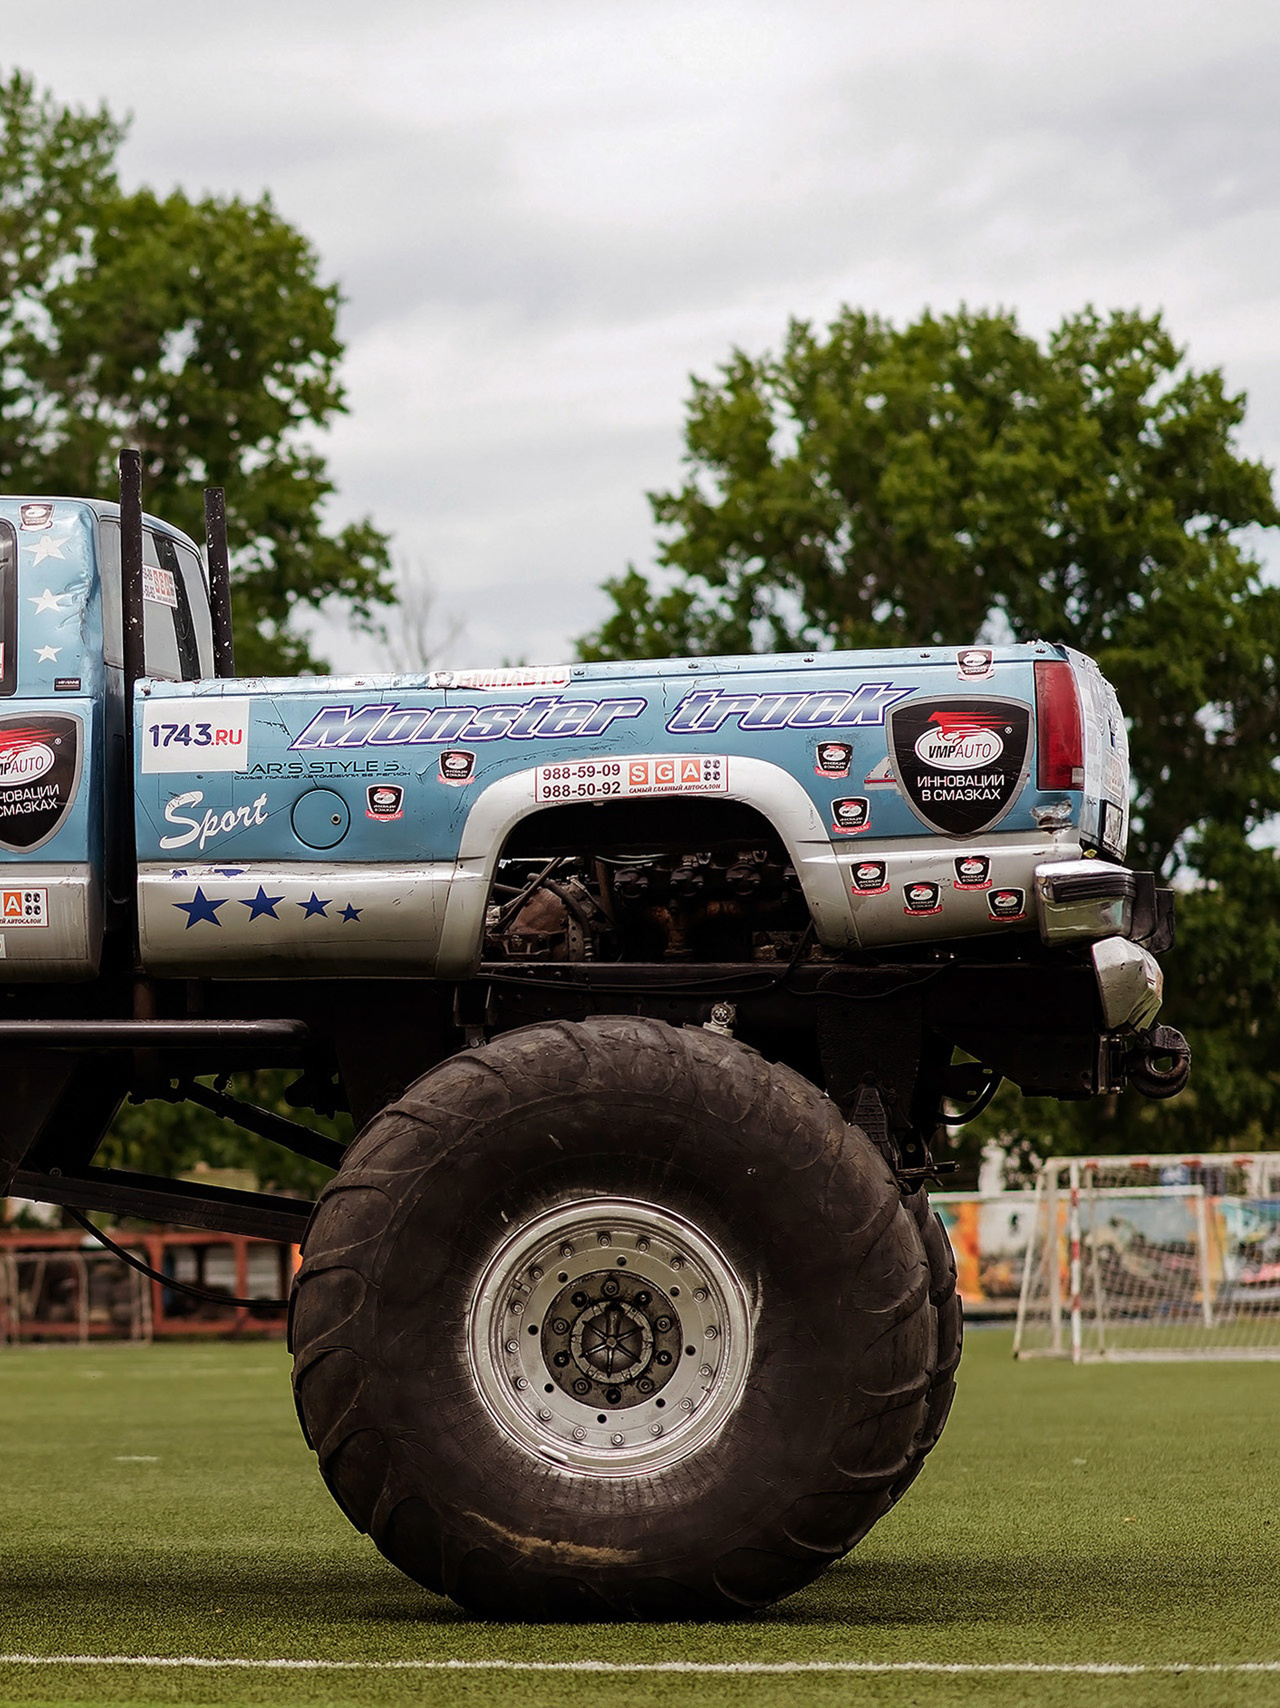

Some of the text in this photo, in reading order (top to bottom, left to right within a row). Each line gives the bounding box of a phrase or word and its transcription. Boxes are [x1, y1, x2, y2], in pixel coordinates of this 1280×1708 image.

[289, 683, 919, 750] Monster truck
[148, 723, 242, 748] 1743.RU
[928, 743, 992, 758] VMPAUTO
[235, 763, 303, 775] AR'S
[310, 761, 378, 773] STYLE
[542, 763, 621, 781] 988-59-09
[630, 762, 700, 783] SGA
[542, 781, 621, 798] 988-50-92
[917, 774, 1005, 788] ИННОВАЦИИ
[922, 788, 1001, 801] В СМАЗКАХ
[160, 790, 268, 850] Sport
